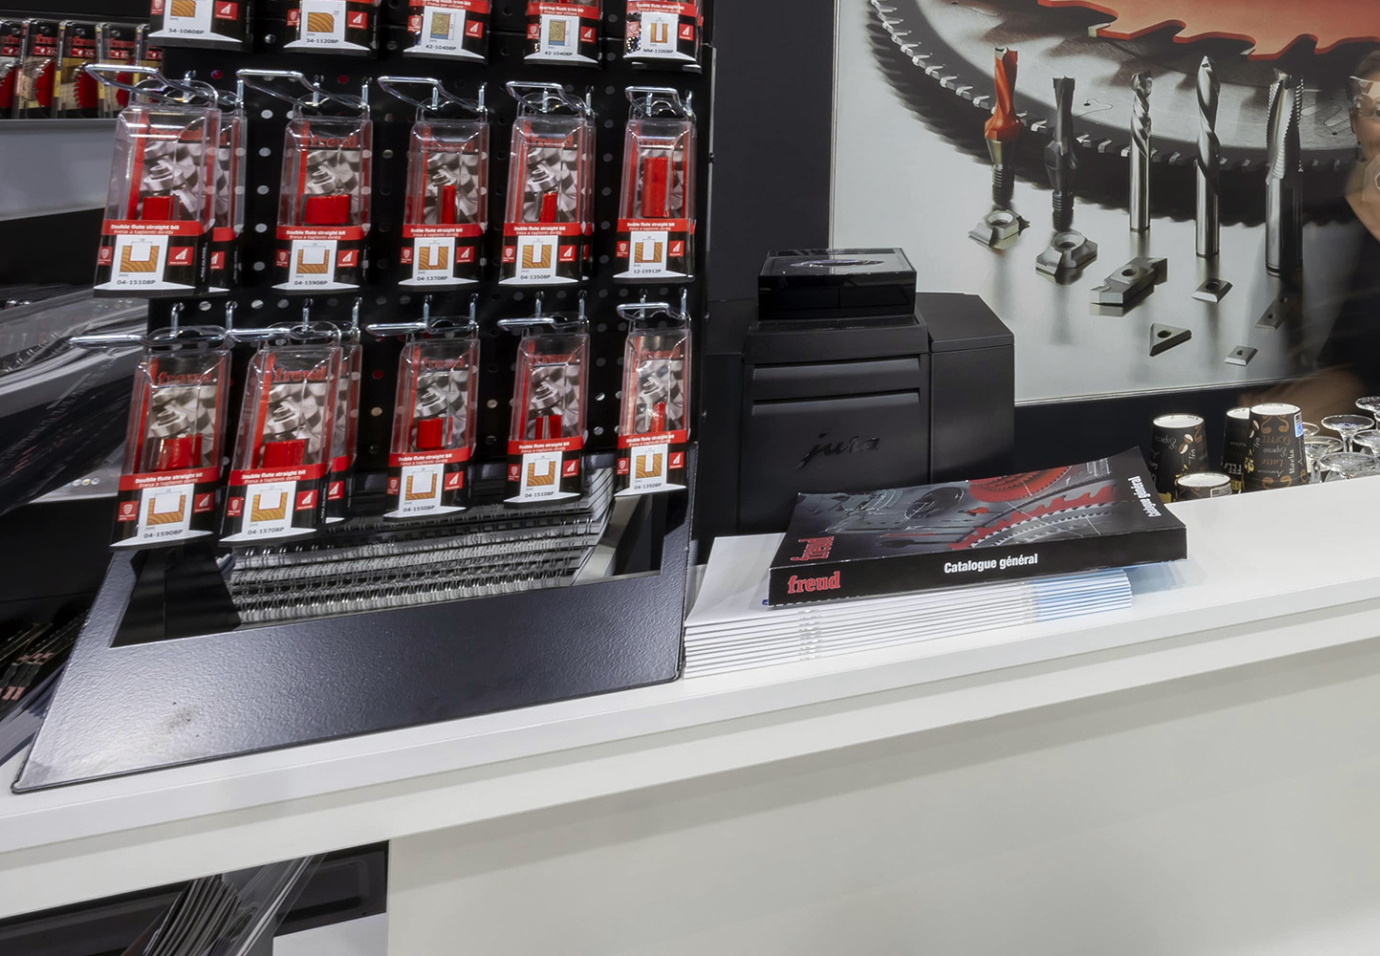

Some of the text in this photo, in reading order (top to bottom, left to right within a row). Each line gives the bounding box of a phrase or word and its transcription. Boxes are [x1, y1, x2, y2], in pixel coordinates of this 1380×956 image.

[944, 553, 1038, 574] Catalogue général
[787, 570, 841, 594] freud
